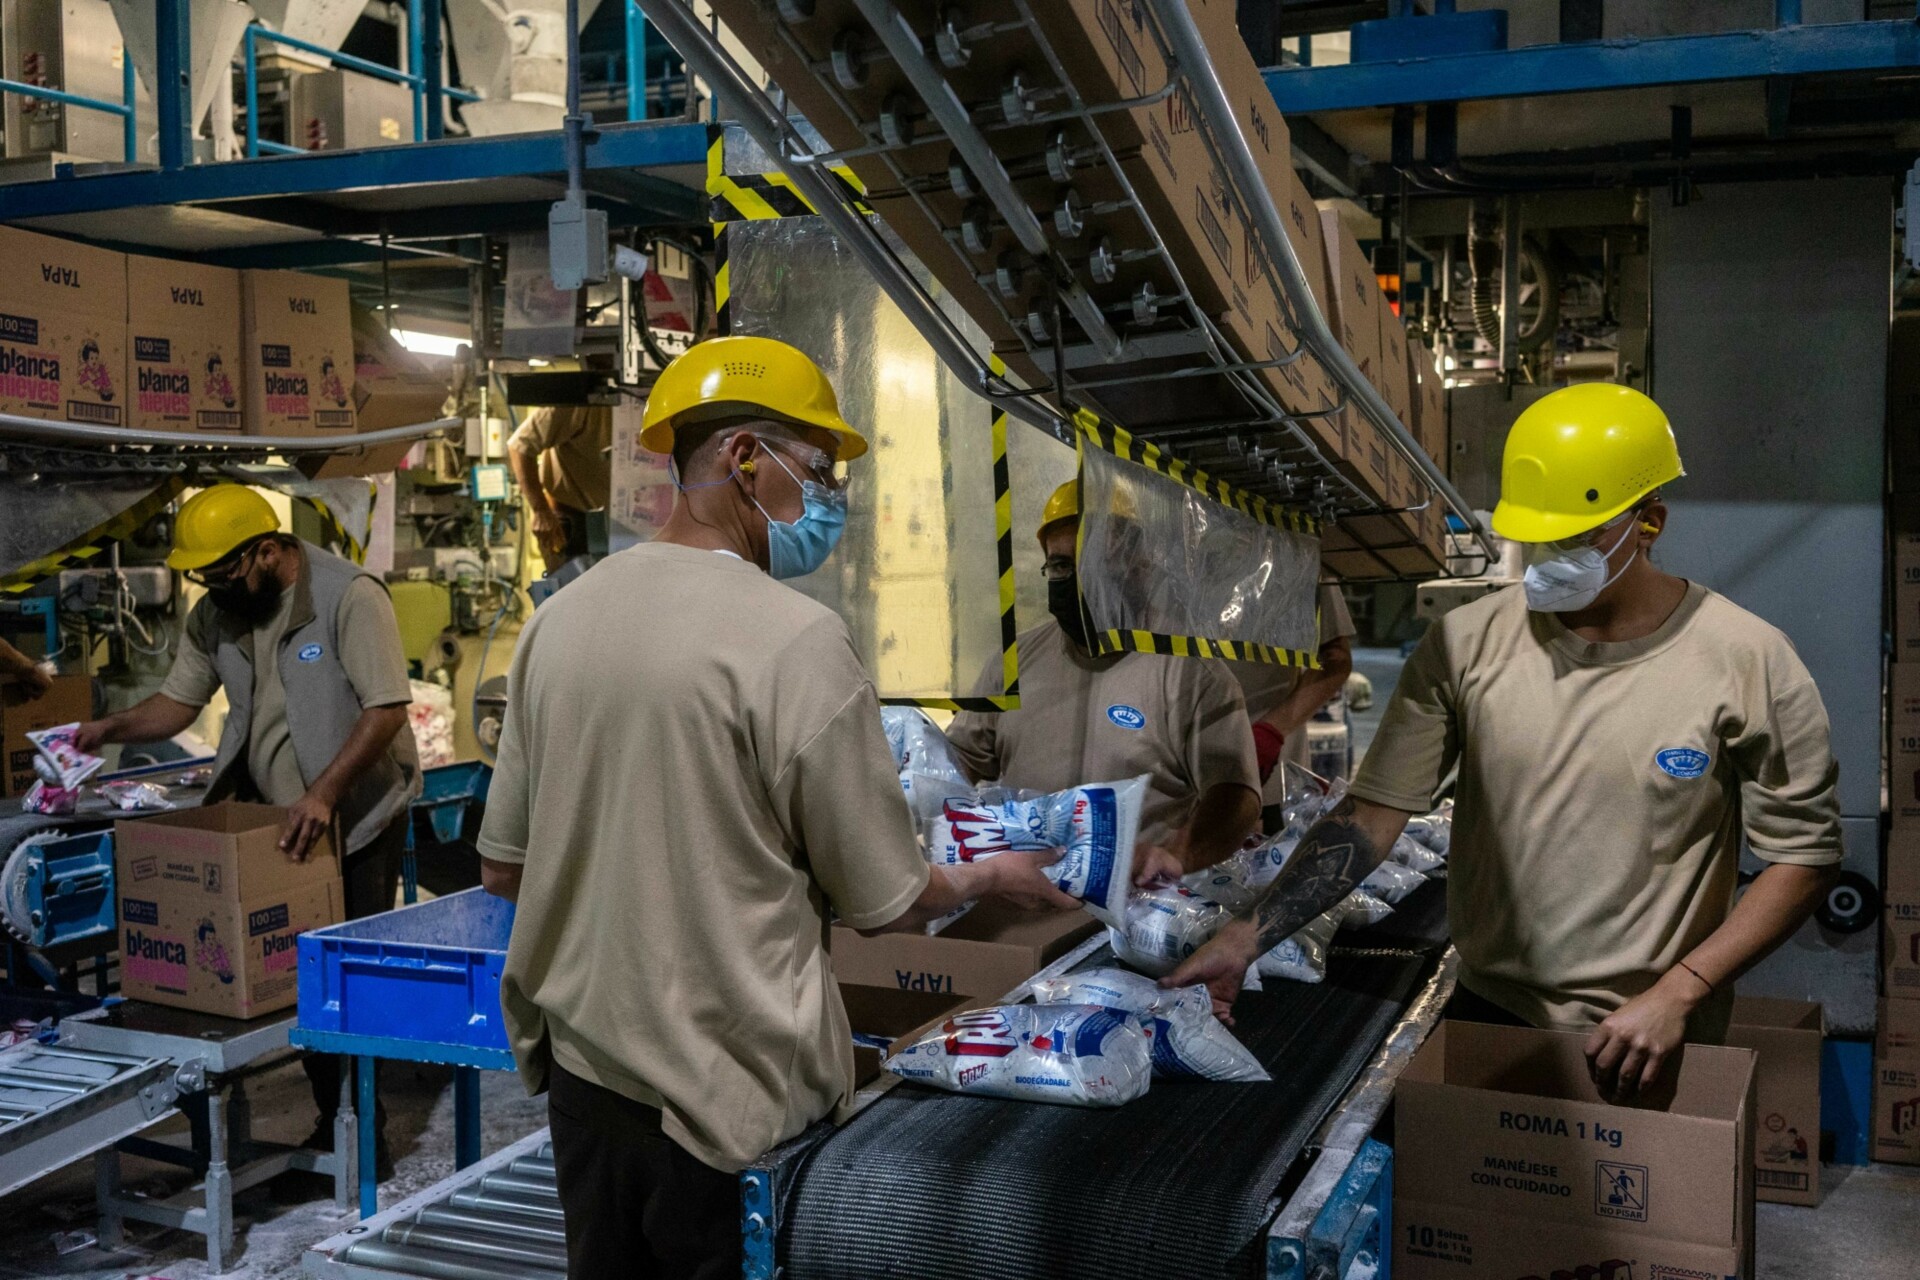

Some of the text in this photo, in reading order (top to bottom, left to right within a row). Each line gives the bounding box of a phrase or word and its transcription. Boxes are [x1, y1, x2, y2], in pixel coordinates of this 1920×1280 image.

[1250, 97, 1270, 154] TAPA
[41, 263, 80, 288] TAPA
[170, 287, 204, 306] TAPA
[288, 297, 317, 315] TAPA
[0, 318, 18, 332] 100
[136, 340, 154, 353] 100
[263, 346, 278, 359] 100
[0, 346, 60, 381] blanca
[138, 366, 189, 393] blanca
[265, 372, 308, 395] blanca
[124, 902, 141, 915] 100
[250, 911, 270, 928] 100
[126, 927, 187, 966] blanca
[263, 929, 306, 957] blan
[896, 970, 957, 995] TAPA
[959, 1063, 991, 1088] ROMA
[1015, 1075, 1072, 1088] BIODEGRADABLE
[1881, 1069, 1897, 1081] 10
[1500, 1111, 1623, 1148] ROMA 1 kg
[1484, 1157, 1558, 1178] MANÉJESE
[1471, 1172, 1571, 1197] CON CUIDADO
[1600, 1206, 1643, 1219] NO PISAR
[1406, 1224, 1434, 1248] 10
